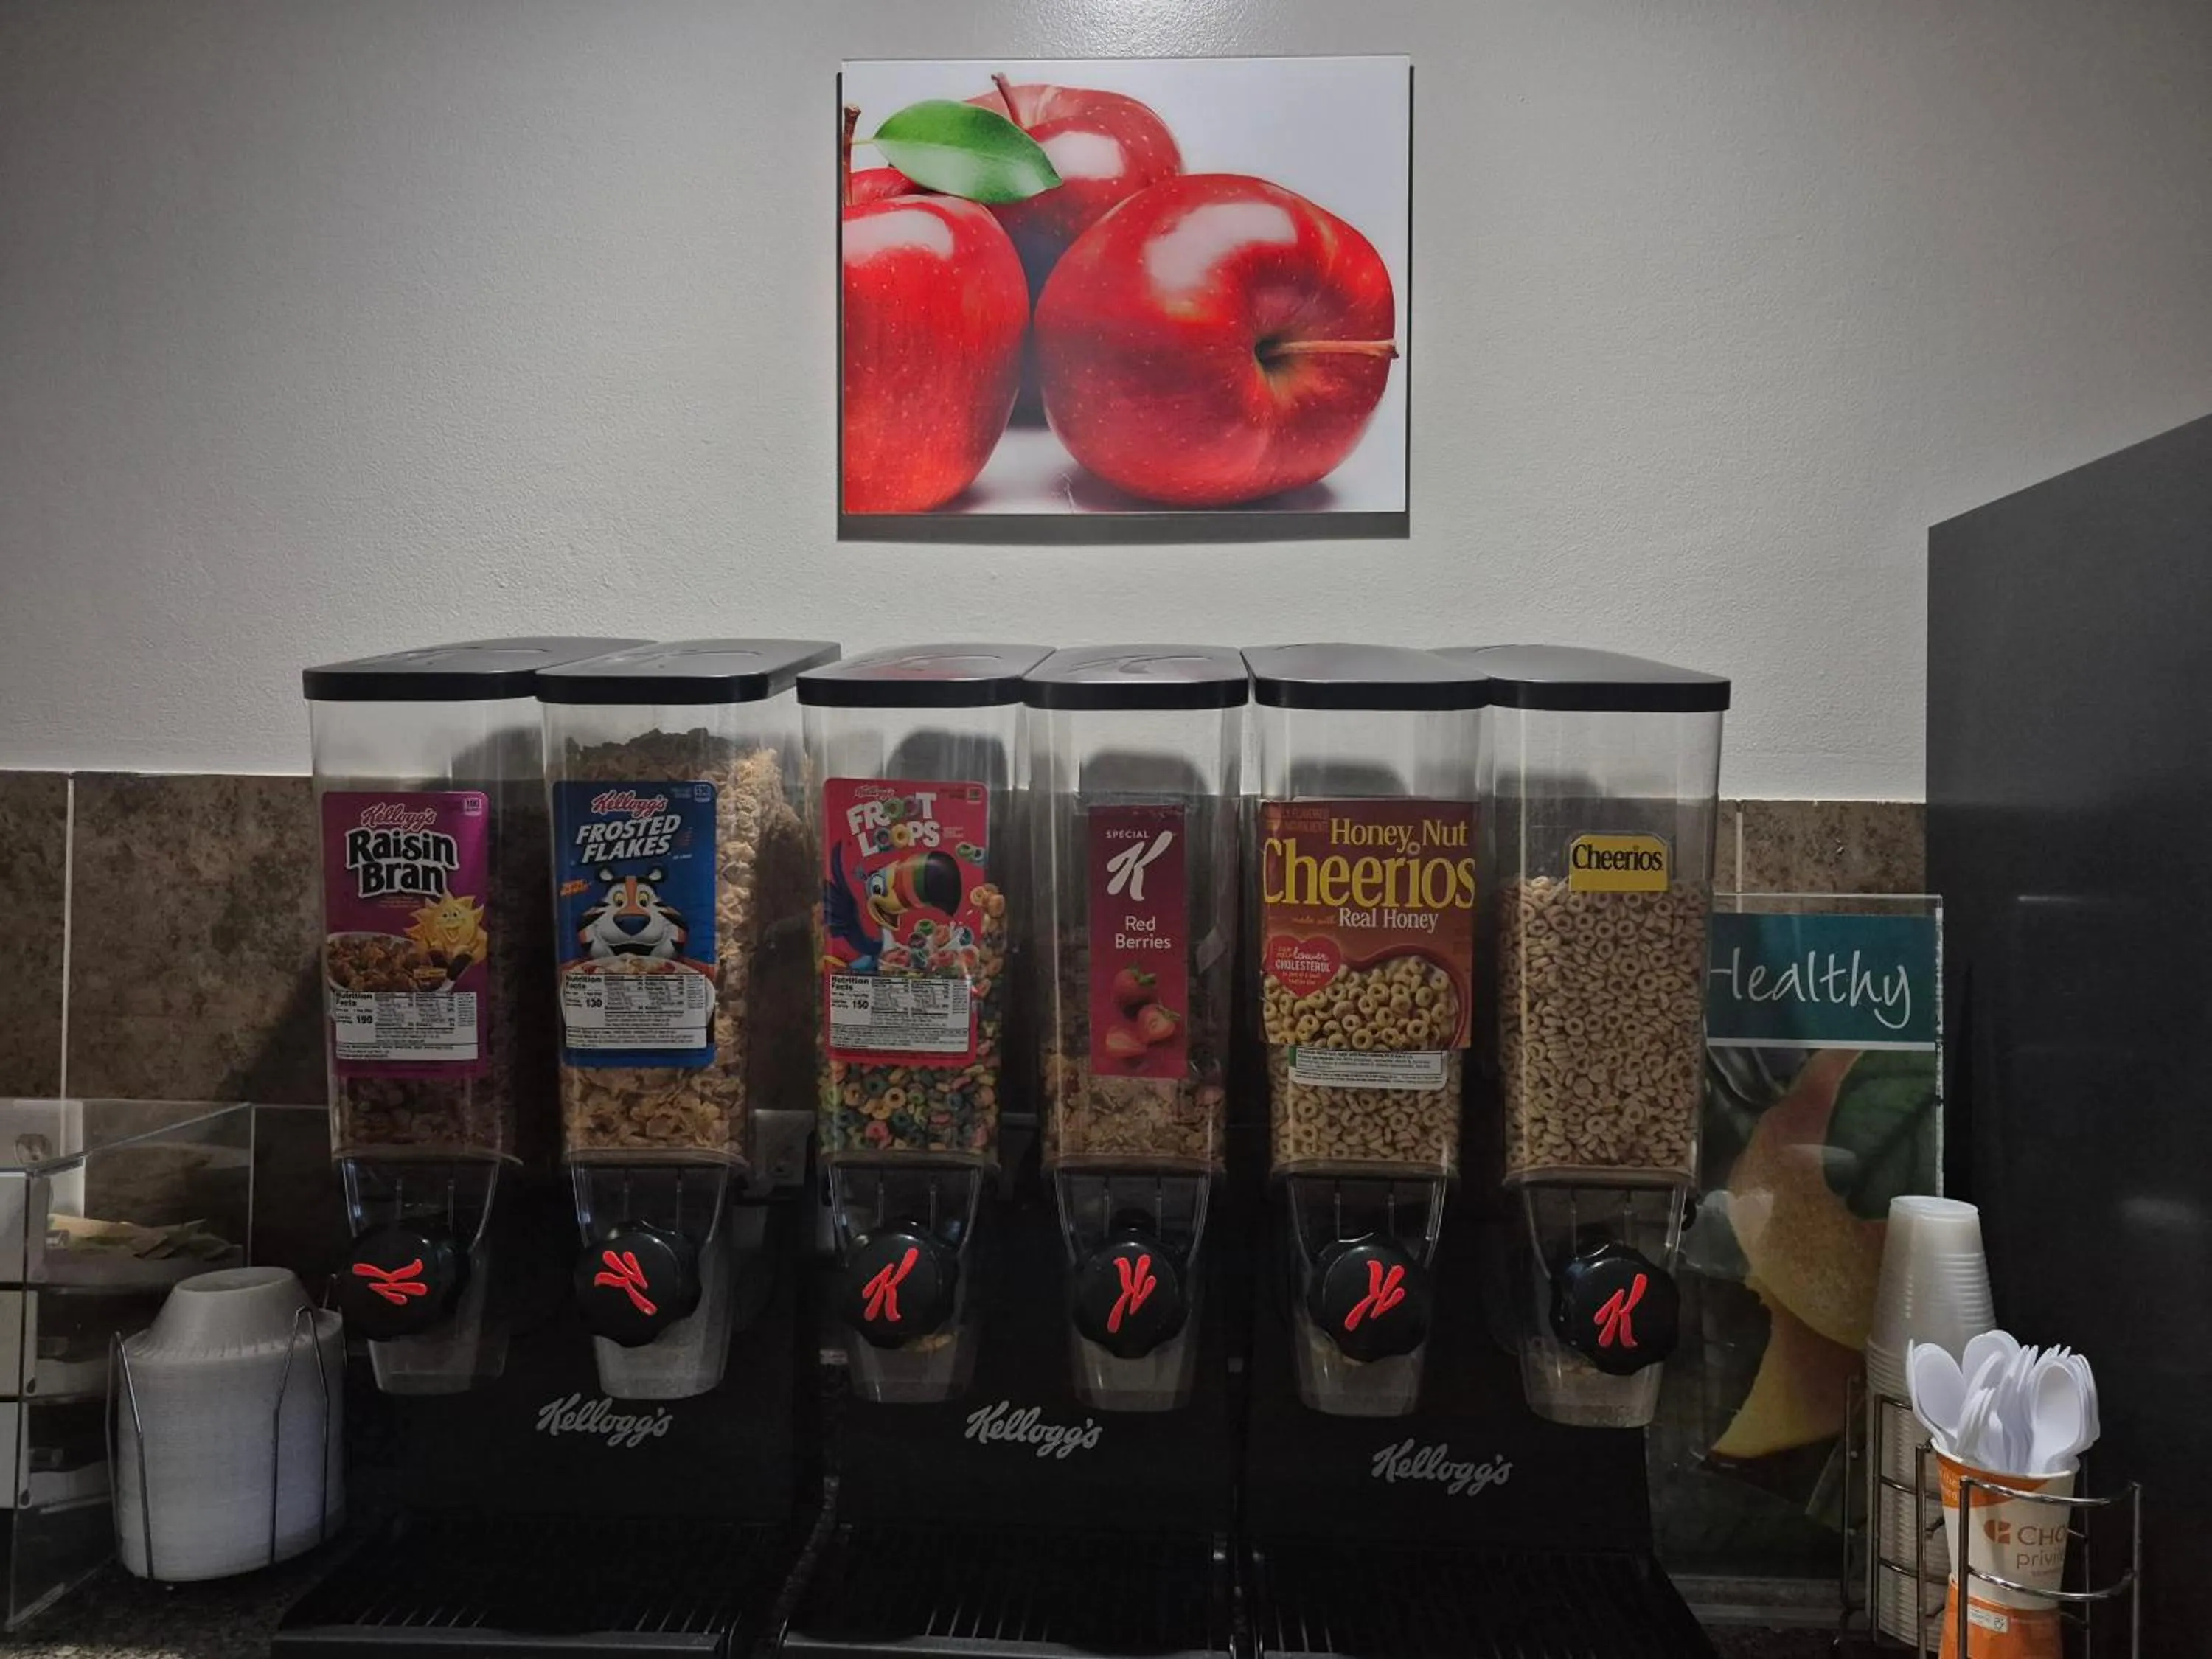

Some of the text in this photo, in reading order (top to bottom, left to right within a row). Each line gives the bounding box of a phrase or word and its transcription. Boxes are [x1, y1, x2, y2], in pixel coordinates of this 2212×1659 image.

[361, 802, 437, 832] Kellogg's
[591, 790, 669, 818] Kellogg's
[846, 792, 937, 835] FROOT
[575, 814, 682, 845] FROSTED
[858, 821, 940, 858] LOOPS
[1105, 830, 1150, 838] SPECIAL
[1330, 818, 1416, 853] Honey
[1422, 819, 1469, 846] Nut
[347, 827, 458, 869] Raisin
[581, 835, 672, 863] FLAKES
[1572, 844, 1664, 871] Cheerios
[360, 862, 445, 896] Bran
[1107, 830, 1173, 901] K
[1263, 838, 1475, 909] Cheerios
[1125, 914, 1156, 931] Red
[1339, 908, 1439, 934] Real Honey
[1115, 933, 1172, 950] Berries
[1275, 959, 1332, 973] CHOLESTEROL
[587, 998, 602, 1008] 130
[852, 999, 869, 1009] 150
[535, 1391, 674, 1448] Kellogg's
[964, 1399, 1104, 1460] Kellogg's
[1371, 1437, 1514, 1498] Kellogg's
